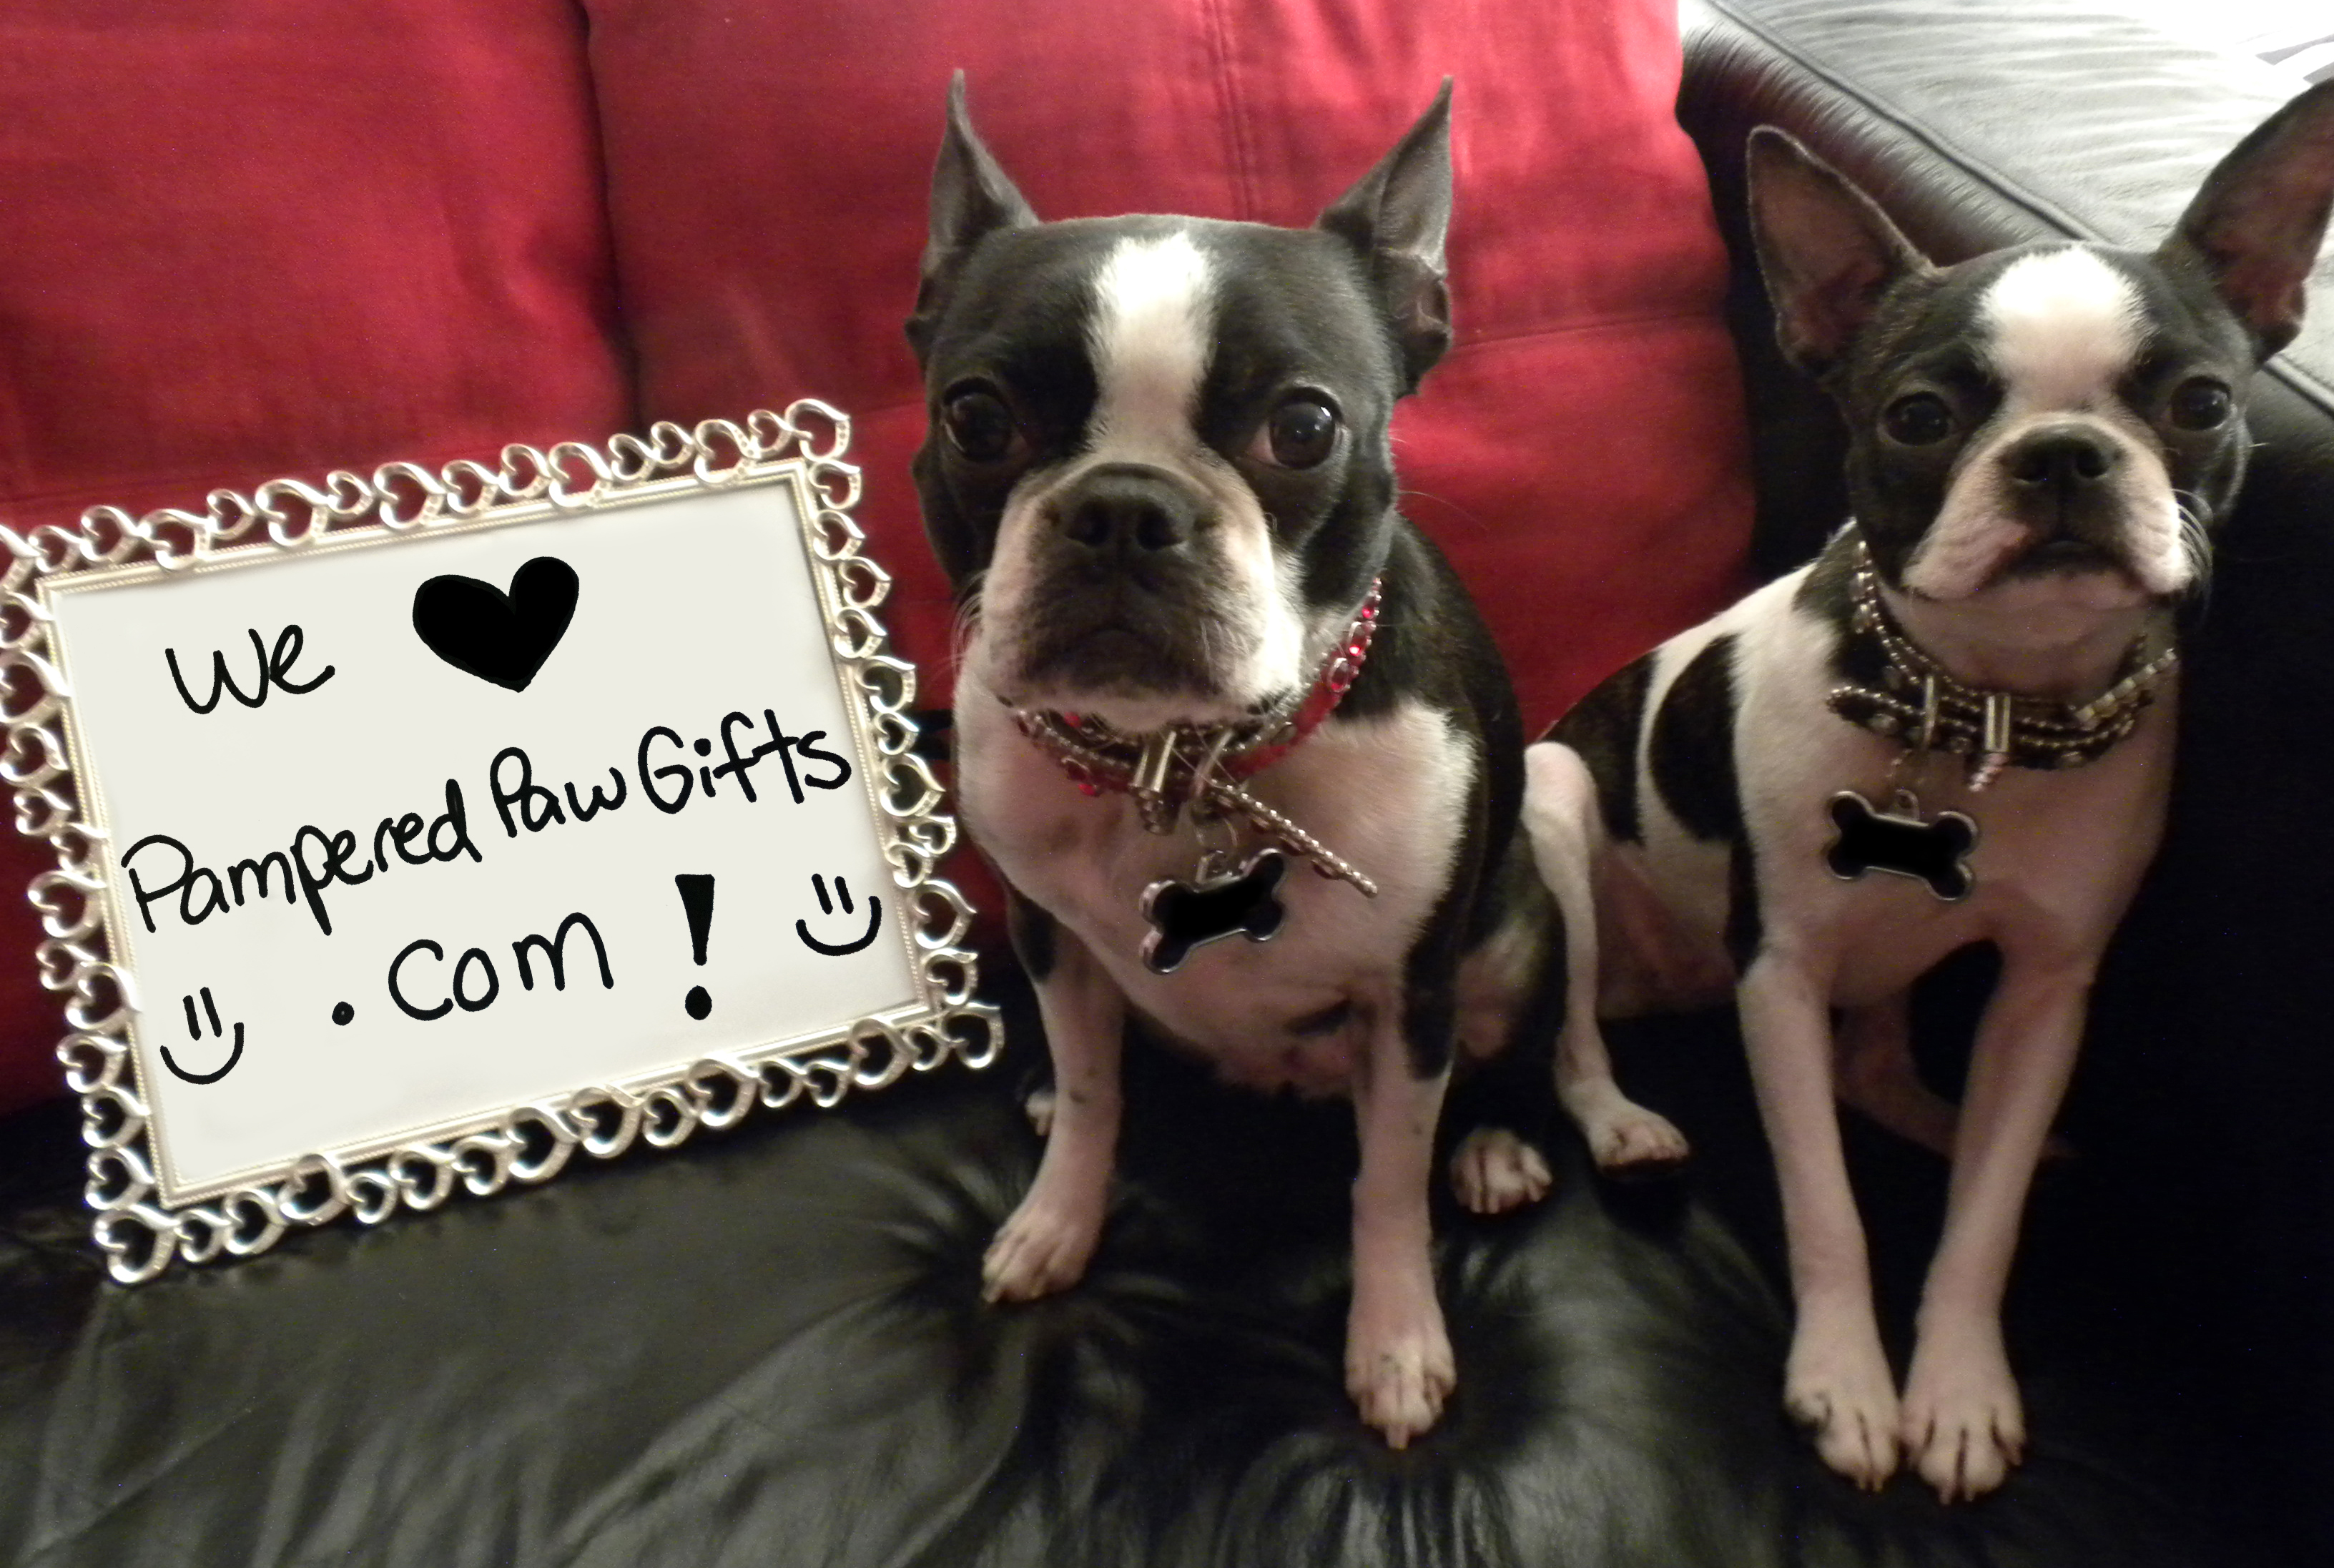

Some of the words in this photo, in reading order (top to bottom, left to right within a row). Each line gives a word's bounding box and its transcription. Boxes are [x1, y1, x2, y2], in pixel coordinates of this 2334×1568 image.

[121, 779, 482, 936] Pampered
[490, 747, 627, 838] Paw
[638, 709, 852, 814] Gifts
